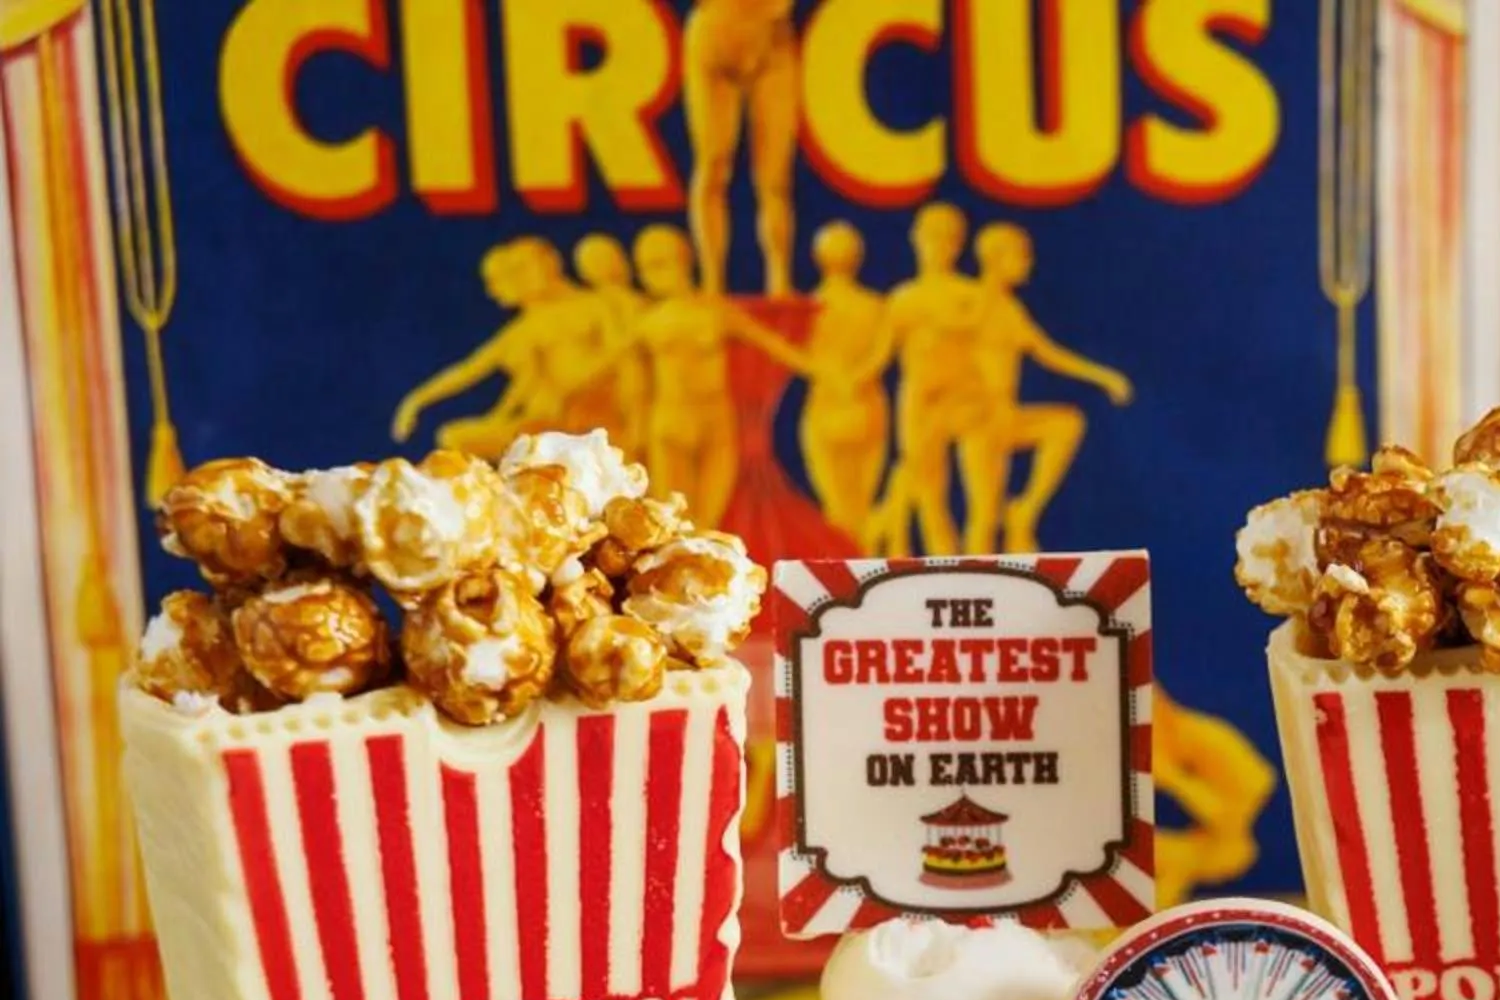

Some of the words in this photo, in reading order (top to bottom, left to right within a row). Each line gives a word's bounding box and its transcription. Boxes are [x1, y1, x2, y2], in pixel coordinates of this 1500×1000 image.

[217, 0, 1282, 221] CIRCUS
[925, 598, 995, 628] THE
[822, 637, 1097, 685] GREATEST
[883, 696, 1040, 742] SHOW
[866, 753, 916, 787] ON
[929, 752, 1059, 786] EARTH
